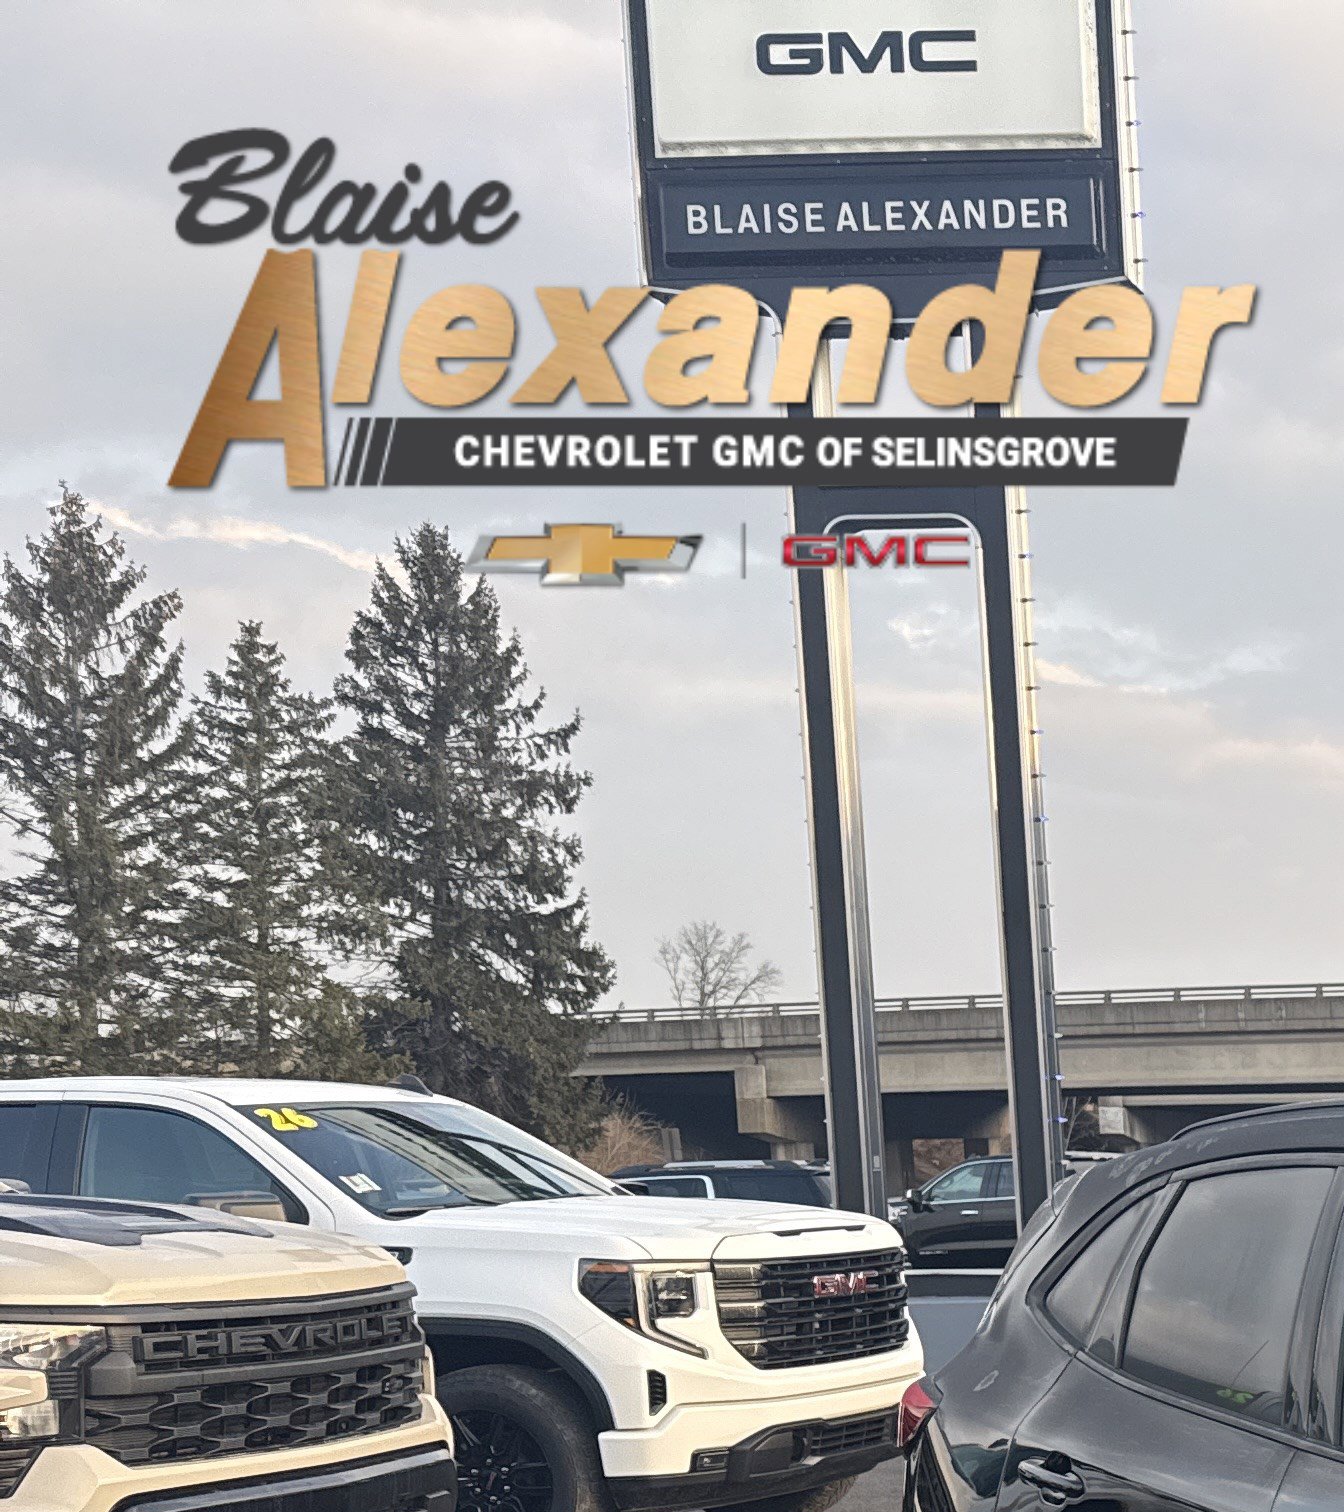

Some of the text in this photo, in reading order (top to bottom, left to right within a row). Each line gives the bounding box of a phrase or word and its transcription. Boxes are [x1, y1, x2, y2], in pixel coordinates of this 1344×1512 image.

[755, 29, 978, 76] GMC
[686, 197, 1069, 235] BLAISE ALEXANDER
[253, 1107, 319, 1131] 26
[813, 1270, 879, 1298] GMC
